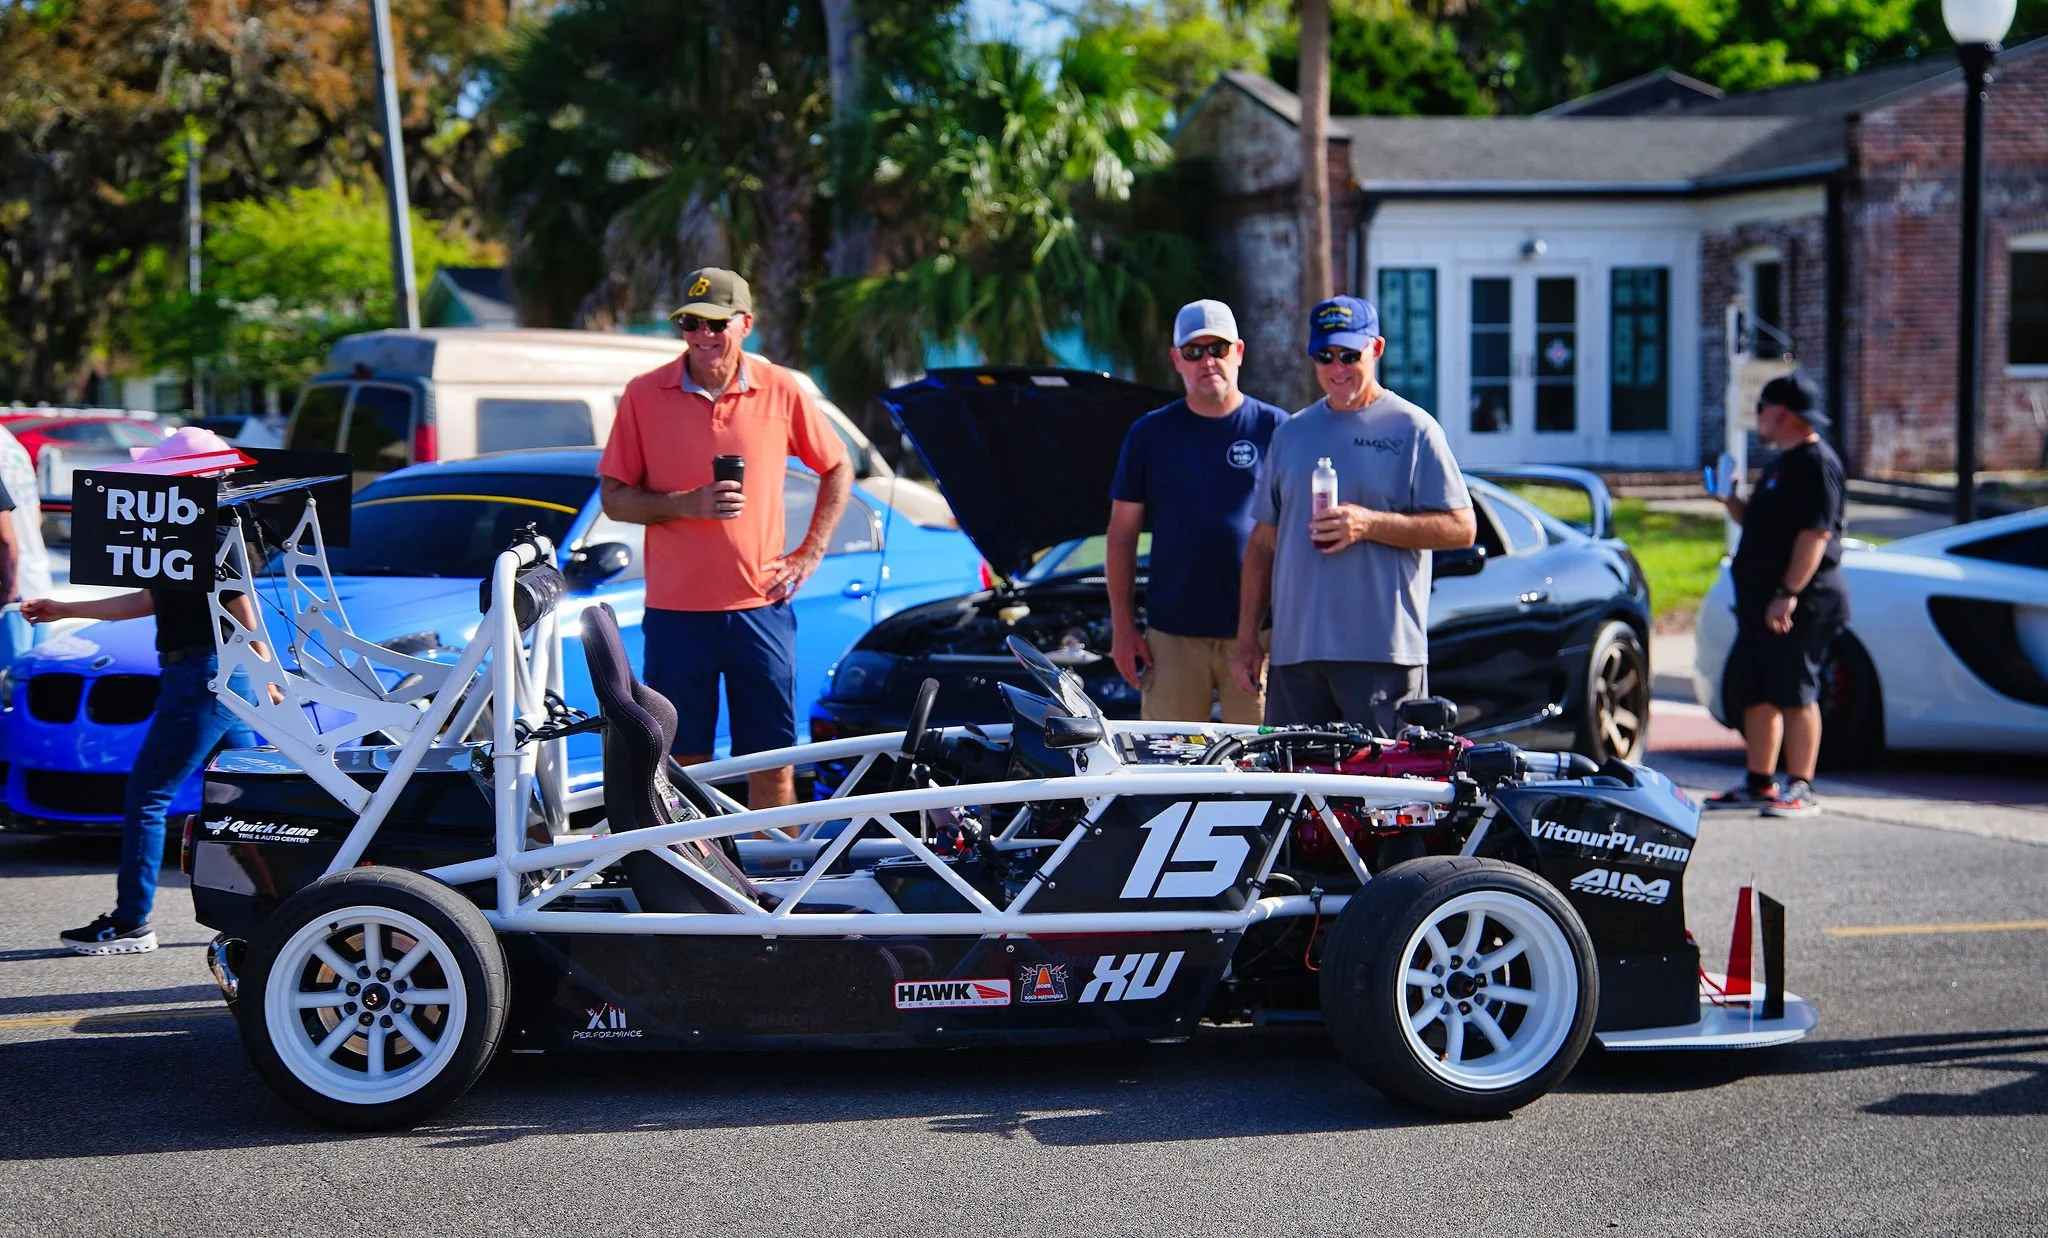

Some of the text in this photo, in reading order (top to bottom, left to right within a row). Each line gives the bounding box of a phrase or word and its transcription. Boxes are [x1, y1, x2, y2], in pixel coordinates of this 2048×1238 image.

[105, 545, 194, 580] TUG
[229, 820, 319, 837] Quick Lane
[238, 832, 254, 840] TIRE
[281, 836, 310, 844] CENTER
[1530, 818, 1690, 863] VitourP1.com
[1119, 800, 1273, 899] 15
[1570, 868, 1671, 898] AIM
[1078, 950, 1186, 1003] XU
[898, 983, 972, 1002] HAWK
[572, 1030, 643, 1040] PERFORMANCE
